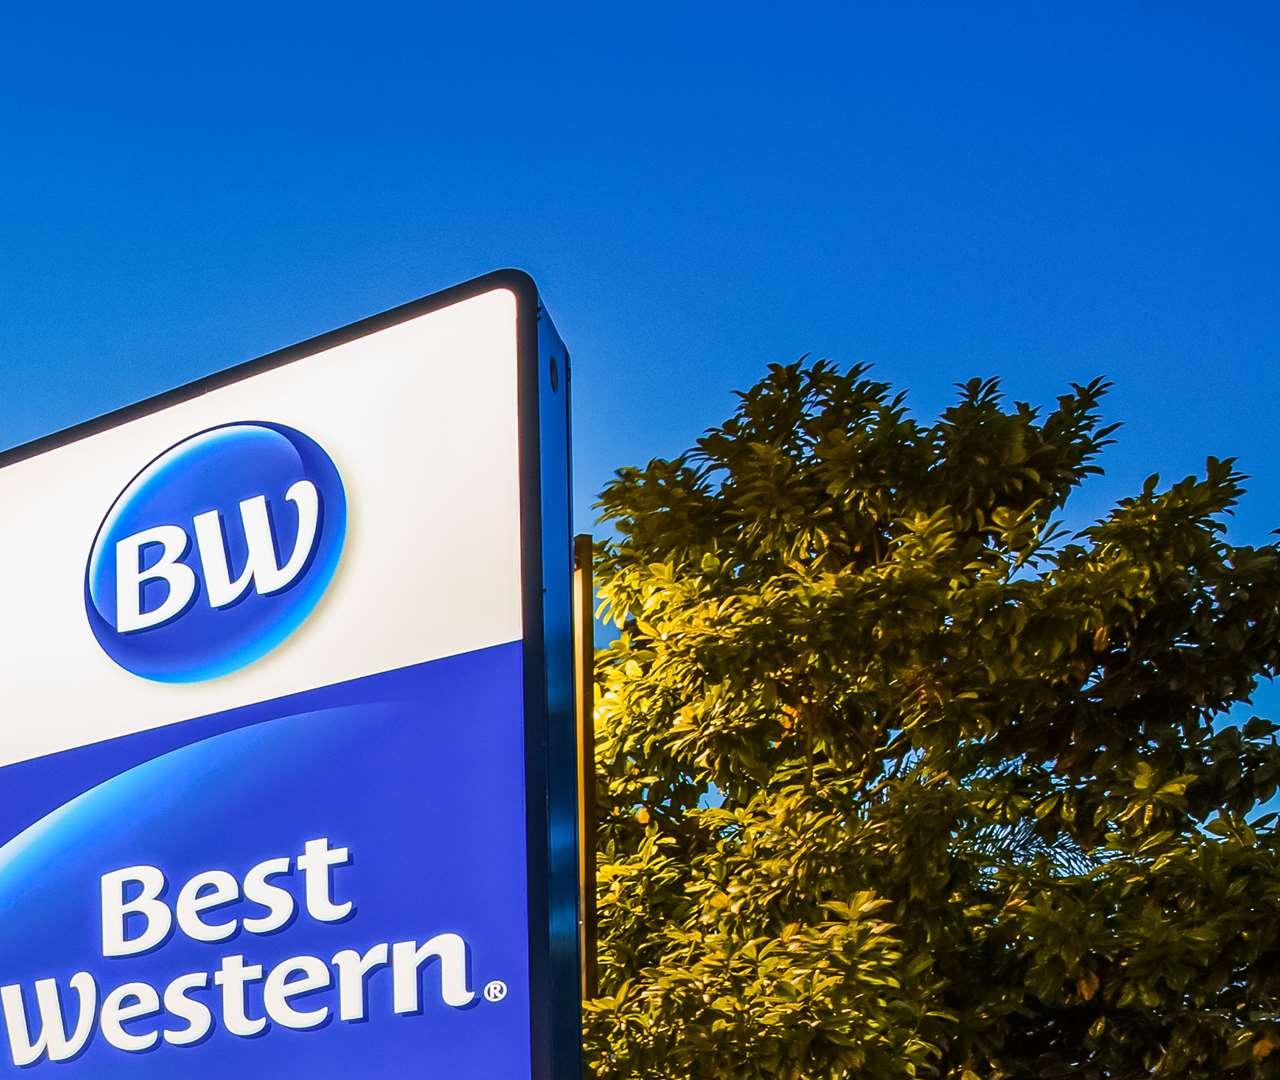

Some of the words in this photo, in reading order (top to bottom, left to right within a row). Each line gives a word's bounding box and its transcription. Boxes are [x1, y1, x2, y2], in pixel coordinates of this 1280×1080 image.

[116, 480, 319, 633] BW
[100, 837, 353, 957] Best
[0, 933, 475, 1067] Western
